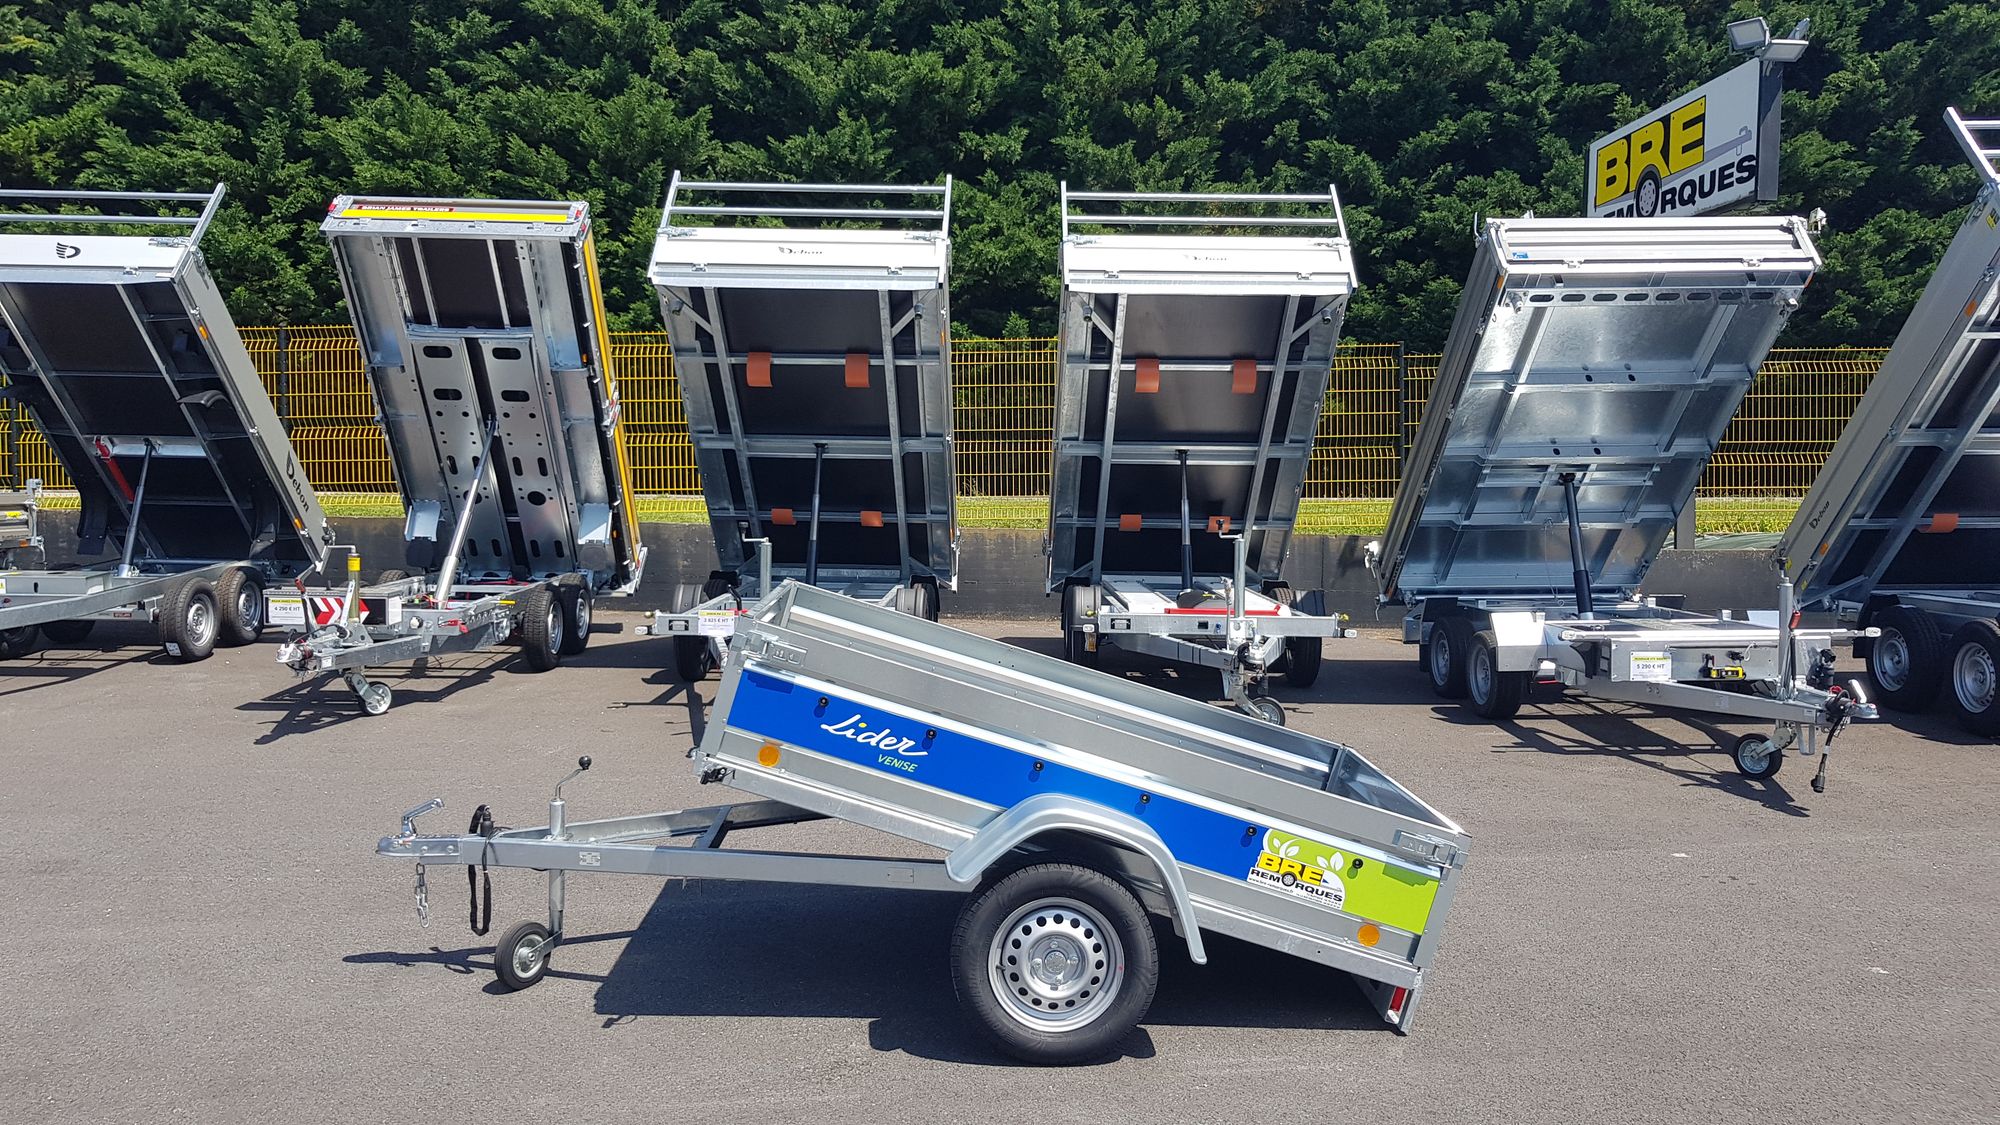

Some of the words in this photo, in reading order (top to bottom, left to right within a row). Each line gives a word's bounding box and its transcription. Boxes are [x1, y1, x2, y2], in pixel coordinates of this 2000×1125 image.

[1595, 94, 1707, 207] BRE
[1603, 154, 1758, 217] MORQUES
[286, 450, 310, 512] Debon
[820, 714, 928, 756] Lider
[877, 754, 918, 773] VENISE
[1250, 868, 1343, 902] REMORQUES
[1257, 851, 1324, 886] BRE
